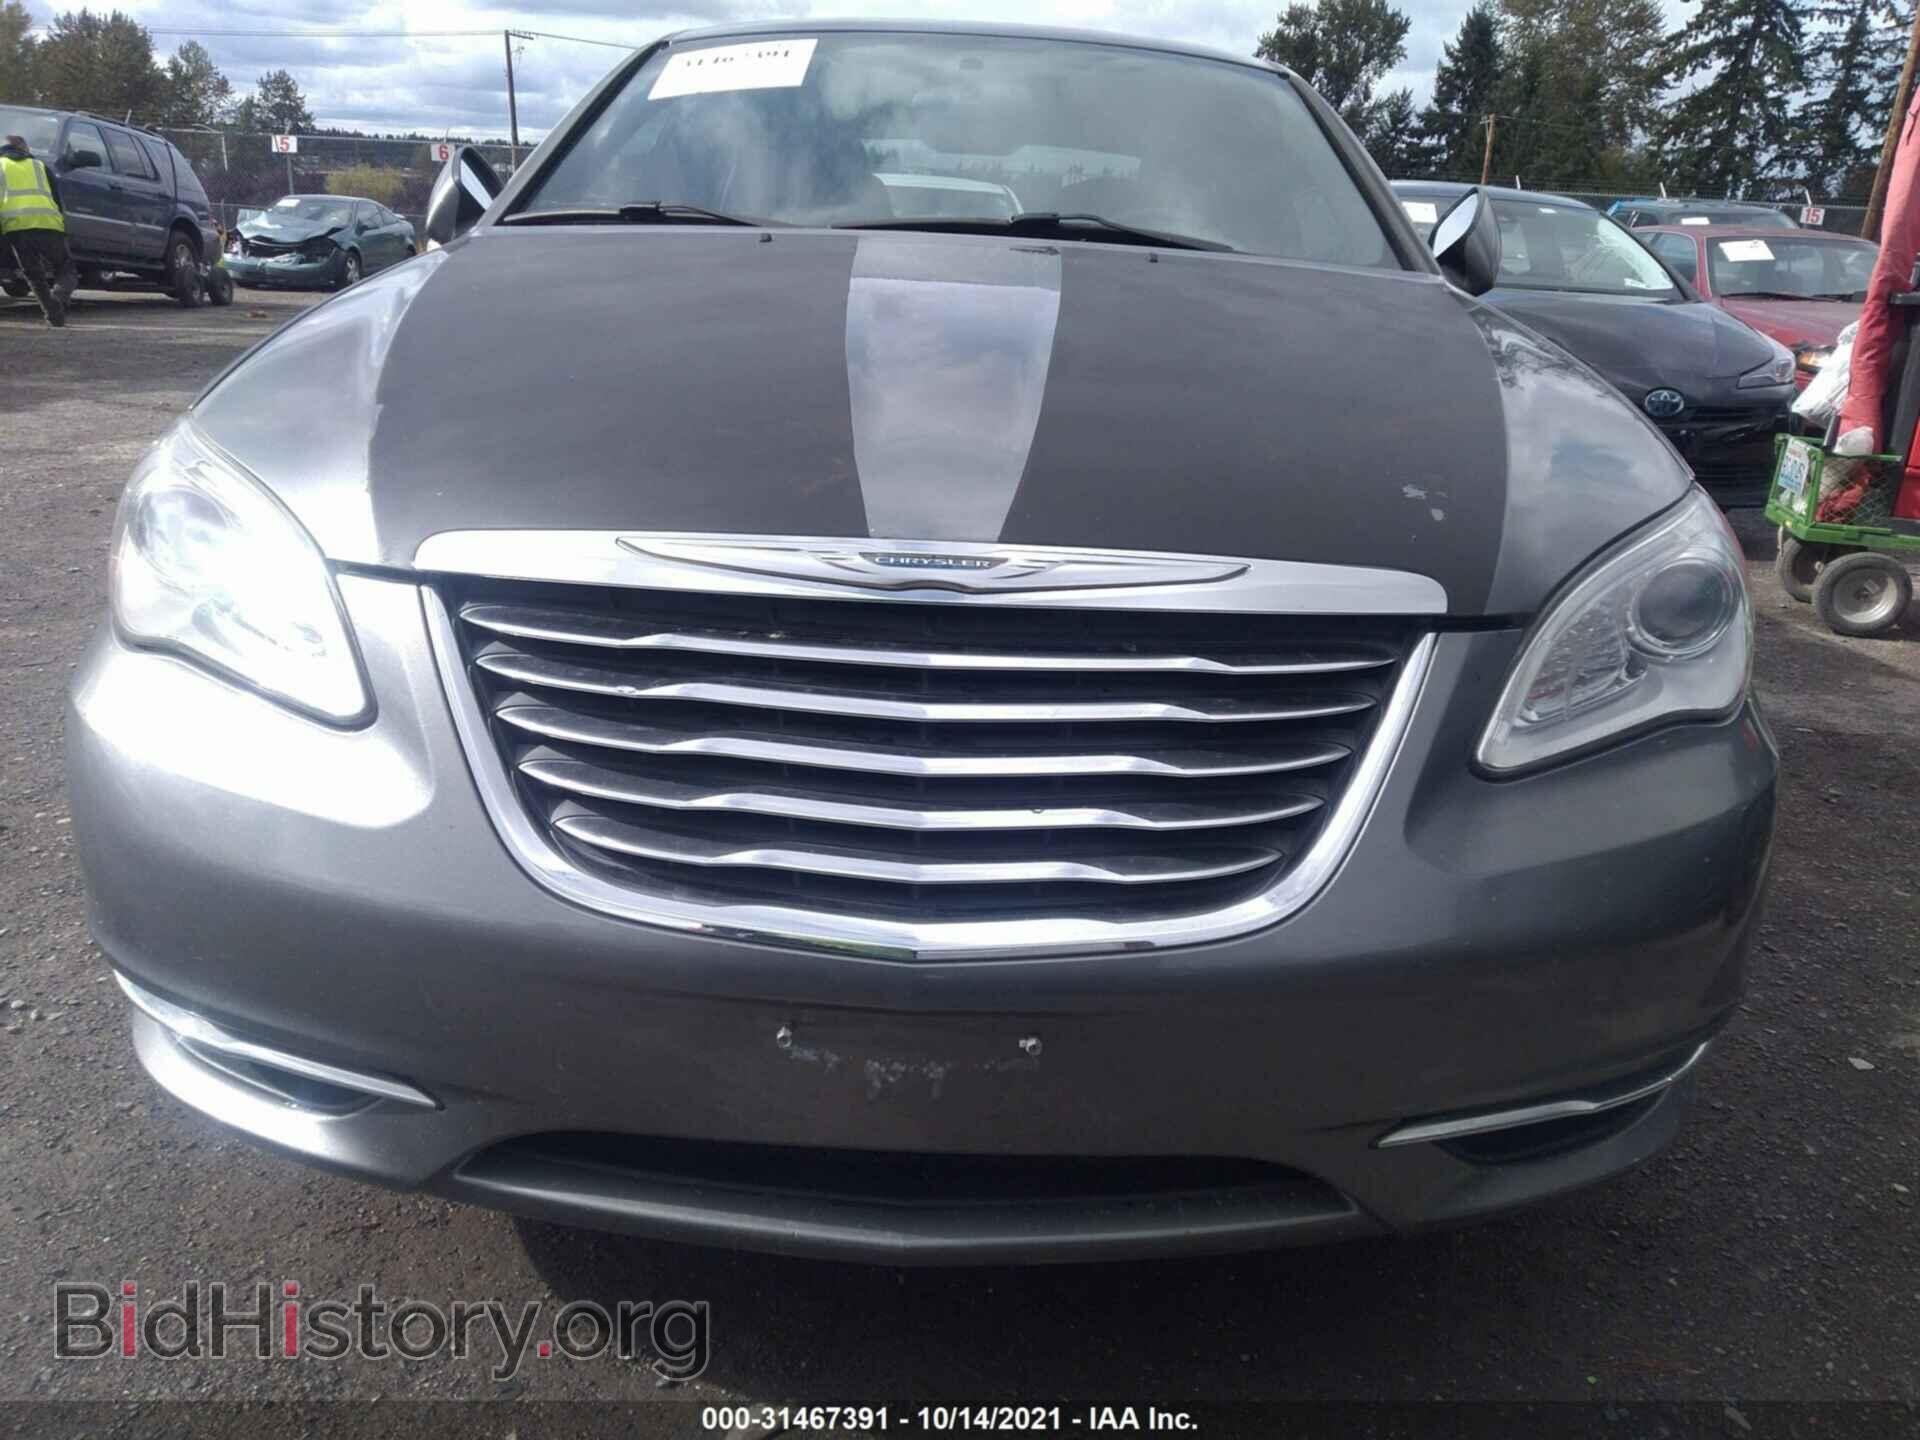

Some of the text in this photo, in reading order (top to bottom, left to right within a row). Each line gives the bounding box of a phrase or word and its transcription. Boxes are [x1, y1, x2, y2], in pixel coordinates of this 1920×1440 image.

[439, 144, 449, 160] 6
[1804, 208, 1821, 224] 15
[874, 556, 992, 569] CHRYSLER
